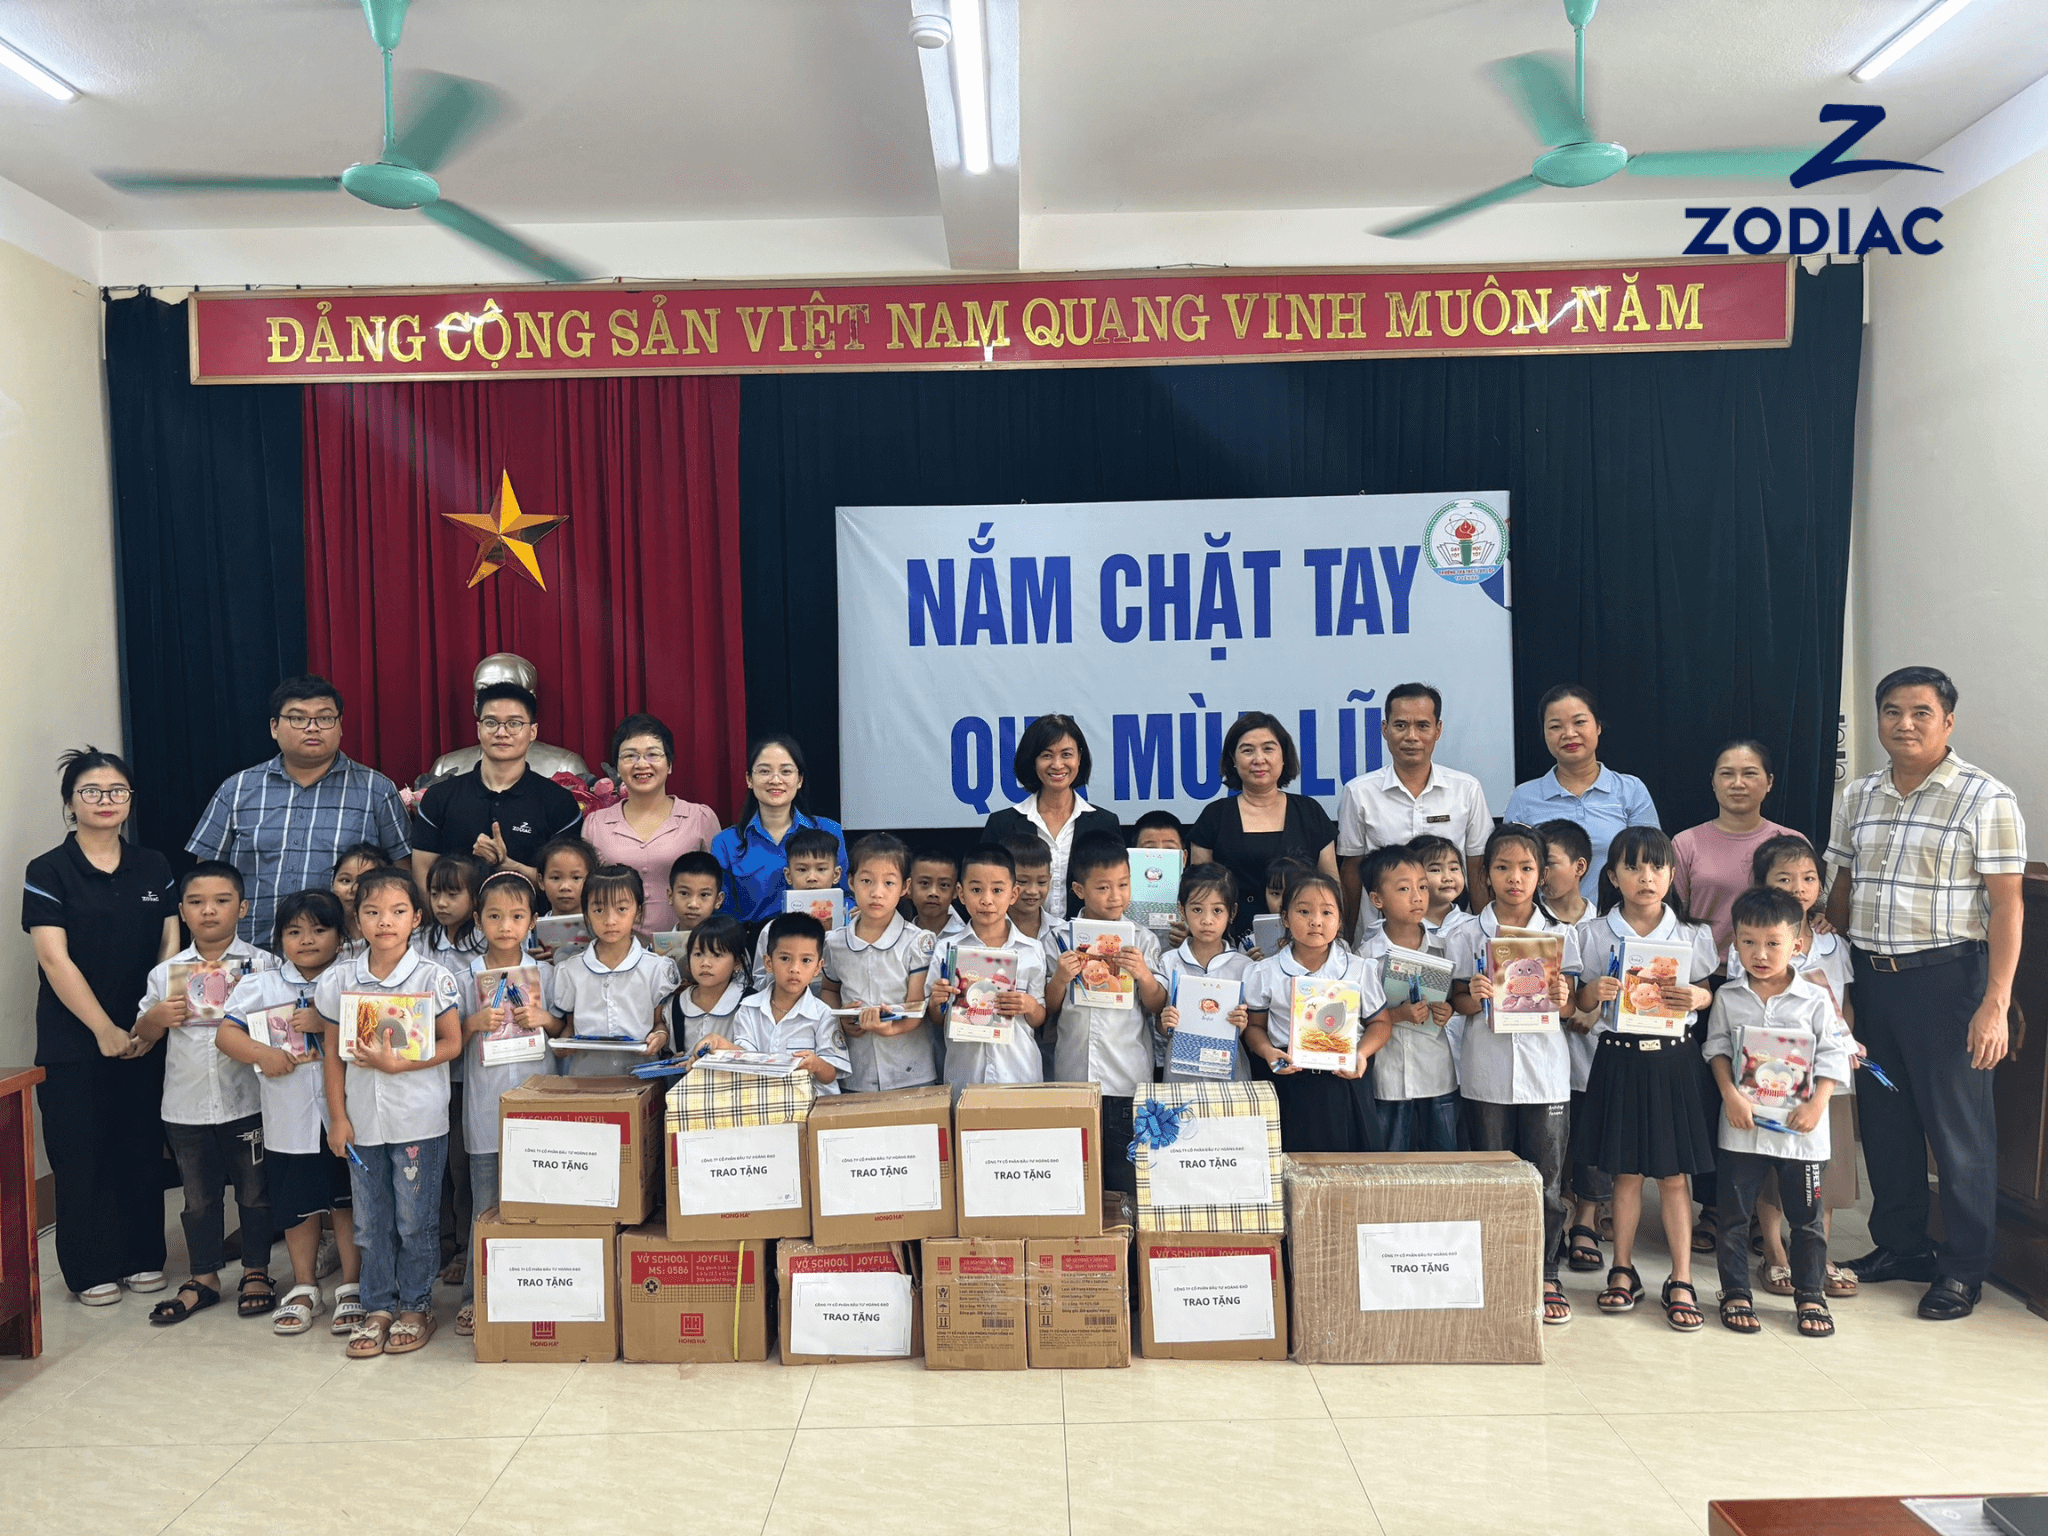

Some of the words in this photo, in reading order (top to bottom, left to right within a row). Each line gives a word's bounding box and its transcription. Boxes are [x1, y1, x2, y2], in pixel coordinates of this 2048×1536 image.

[267, 301, 427, 364] ĐẢNG
[439, 299, 592, 370] CỘNG
[609, 296, 721, 357] SẢN
[736, 291, 870, 360] VIỆT
[886, 297, 1012, 350] NAM
[1021, 294, 1210, 347] QUANG
[1223, 292, 1366, 340] VINH
[1385, 276, 1551, 337] MUÔN
[1572, 271, 1704, 332] NĂM
[907, 522, 1072, 646] NẮM
[1099, 532, 1280, 661] CHẶT
[1303, 545, 1421, 637] TAY
[951, 715, 1088, 814] QU
[1113, 693, 1246, 800] MÙ
[532, 1159, 559, 1169] TRAO
[561, 1160, 589, 1172] TẶNG
[1179, 1159, 1206, 1169] TRAO
[1209, 1157, 1237, 1170] TẶNG
[710, 1168, 738, 1178] TRAO
[740, 1165, 768, 1177] TẶNG
[850, 1168, 878, 1178] TRAO
[880, 1165, 908, 1178] TẶNG
[994, 1171, 1021, 1180] TRAO
[1023, 1168, 1051, 1181] TẶNG
[637, 1252, 650, 1263] VỞ
[652, 1255, 688, 1263] SCHOOL
[696, 1255, 731, 1263] JOYFUL
[796, 1257, 809, 1268] VỞ
[811, 1258, 848, 1268] SCHOOL
[857, 1255, 892, 1266] JOYFUL
[648, 1266, 665, 1275] MS:
[667, 1266, 689, 1275] 0586
[1390, 1264, 1418, 1273] TRAO
[1421, 1262, 1449, 1275] TẶNG
[517, 1278, 543, 1287] TRAO
[545, 1276, 573, 1289] TẶNG
[1183, 1297, 1210, 1306] TRAO
[1212, 1295, 1241, 1307] TẶNG
[823, 1313, 850, 1321] TRAO
[852, 1312, 880, 1324] TẶNG
